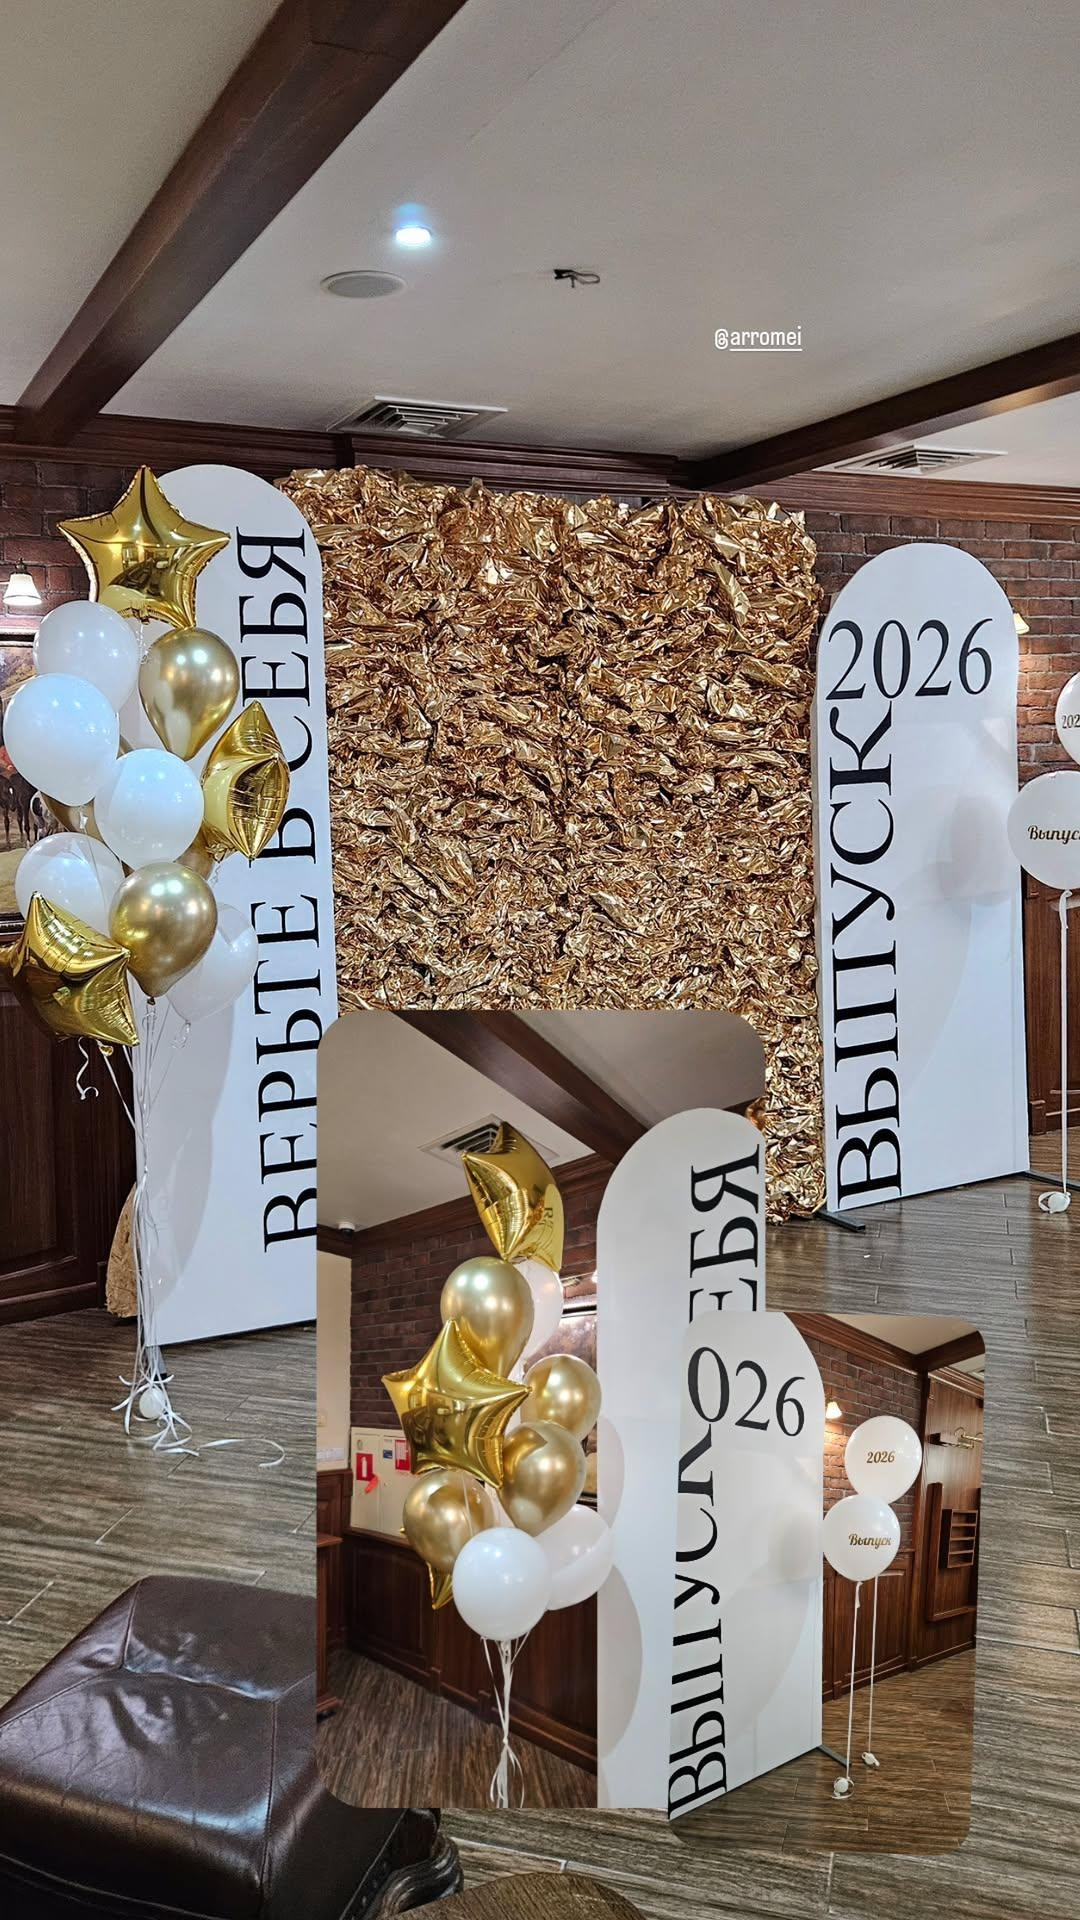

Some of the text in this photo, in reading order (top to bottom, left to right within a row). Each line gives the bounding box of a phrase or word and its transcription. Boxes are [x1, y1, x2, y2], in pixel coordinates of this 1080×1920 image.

[825, 618, 993, 700] 2026
[1062, 713, 1080, 729] 202
[1028, 824, 1080, 845] Выпус
[829, 700, 901, 1209] ВЫПУСК
[250, 894, 323, 1253] ВЕРЬТЕ
[690, 1143, 760, 1324] ЕБЯ
[687, 1346, 806, 1437] 026
[866, 1450, 896, 1464] 2026
[848, 1533, 892, 1550] Выпуск
